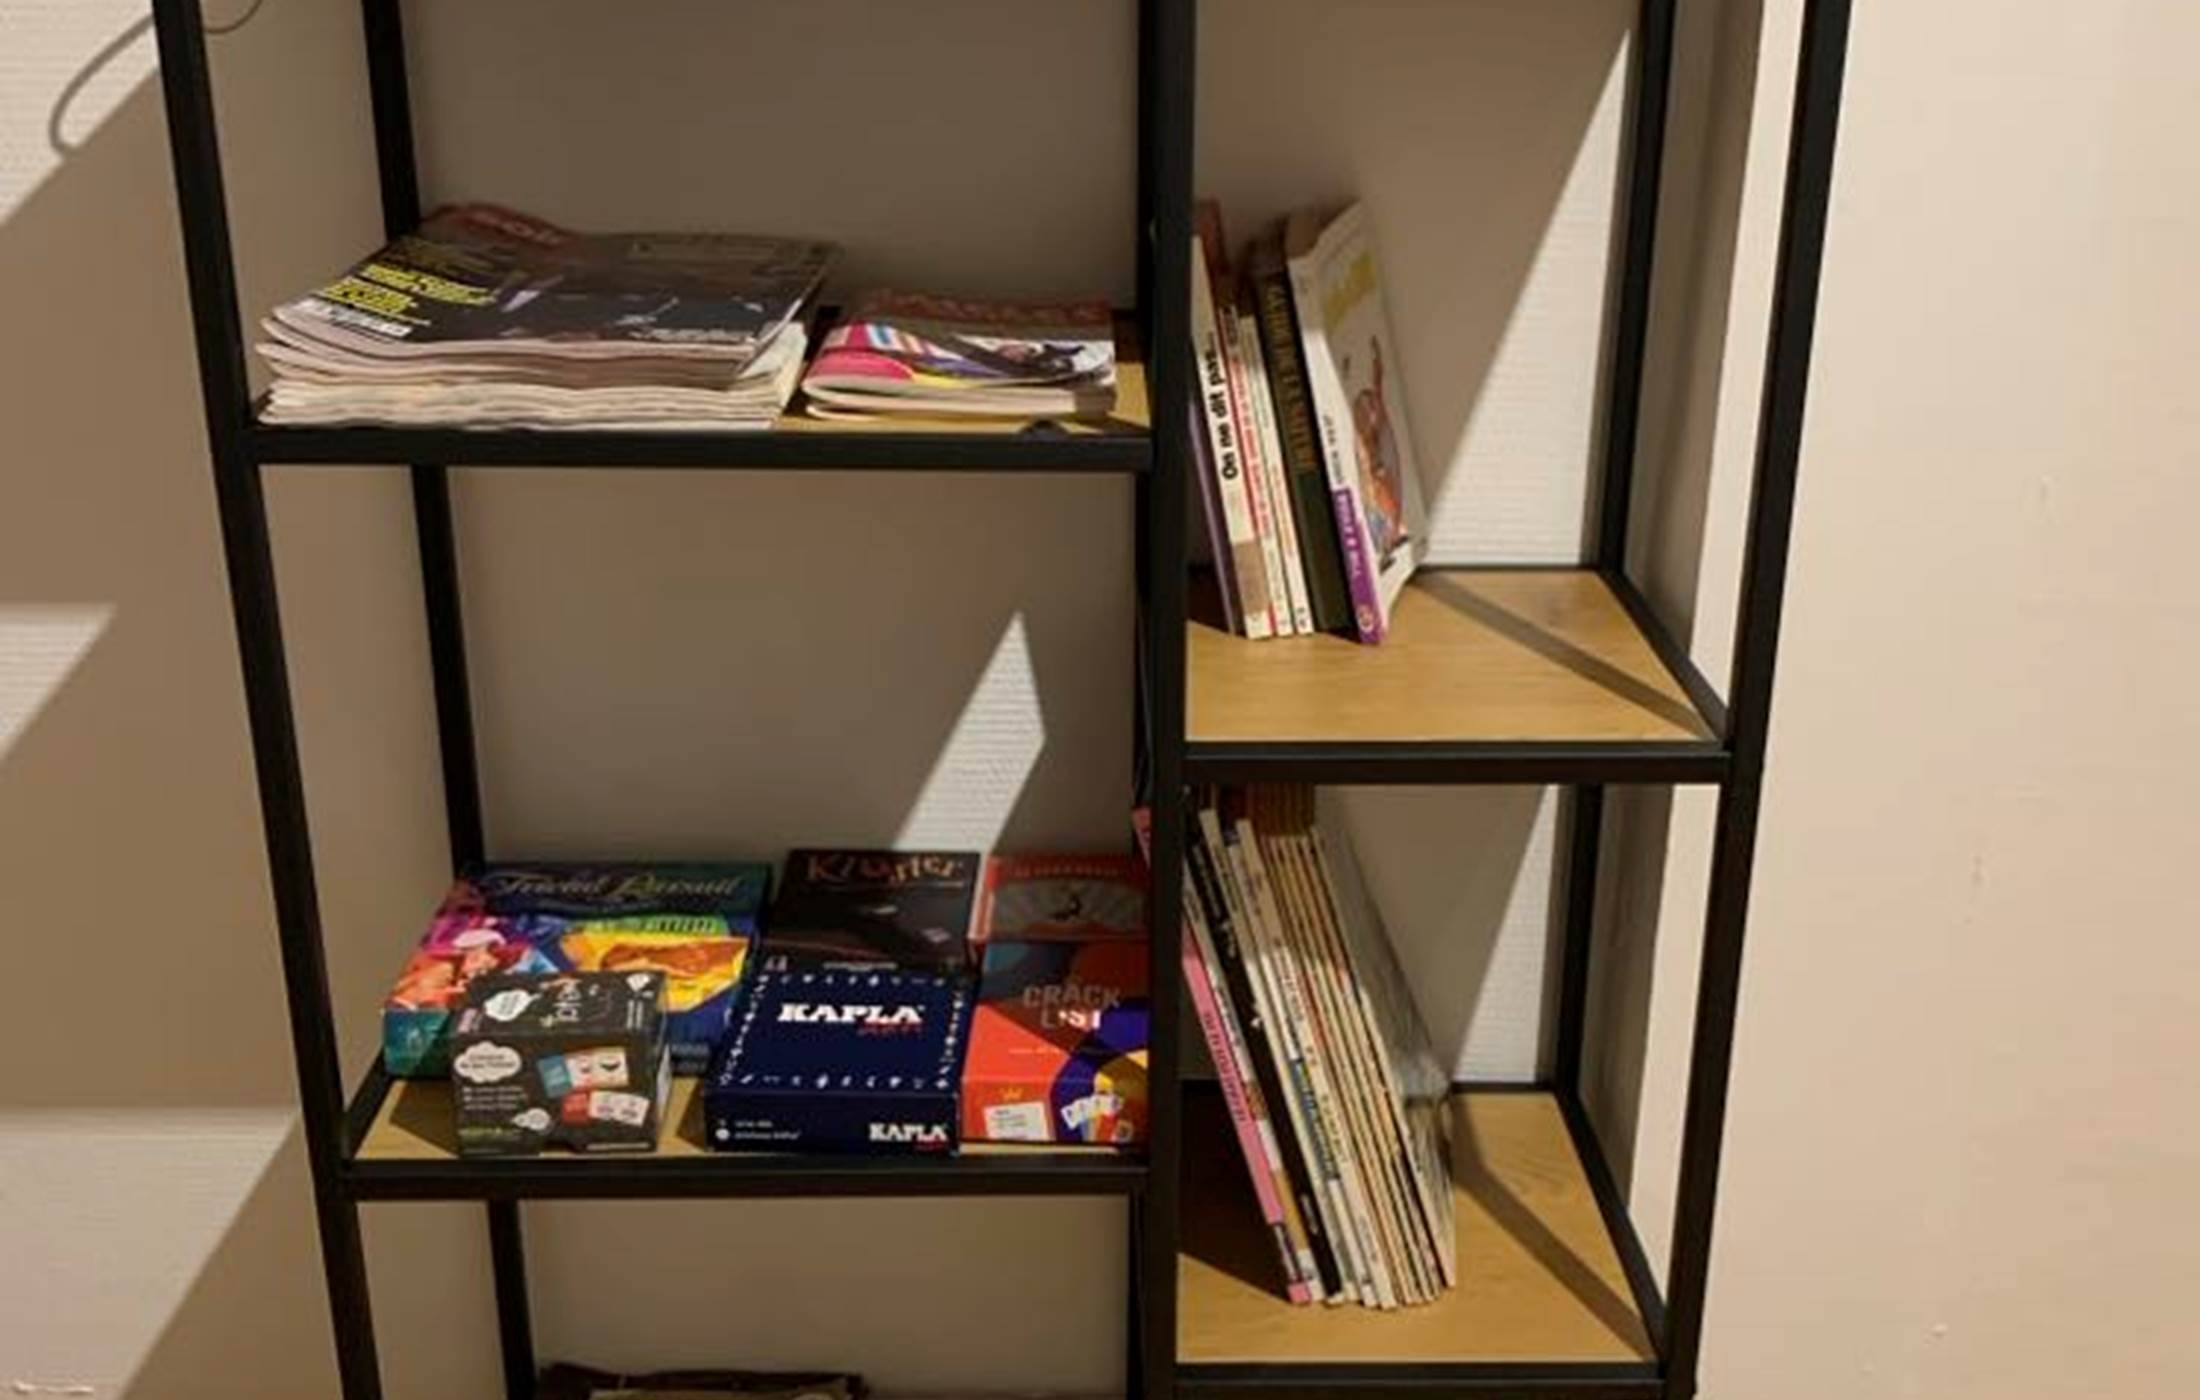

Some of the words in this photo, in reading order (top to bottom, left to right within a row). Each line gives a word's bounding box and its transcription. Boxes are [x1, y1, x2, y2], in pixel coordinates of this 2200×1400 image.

[1210, 385, 1229, 416] dit
[1217, 419, 1234, 446] ne
[1221, 452, 1240, 481] On
[1022, 982, 1121, 1009] CRACK
[778, 1003, 921, 1024] KAPLA
[869, 1122, 948, 1144] KAPLA
